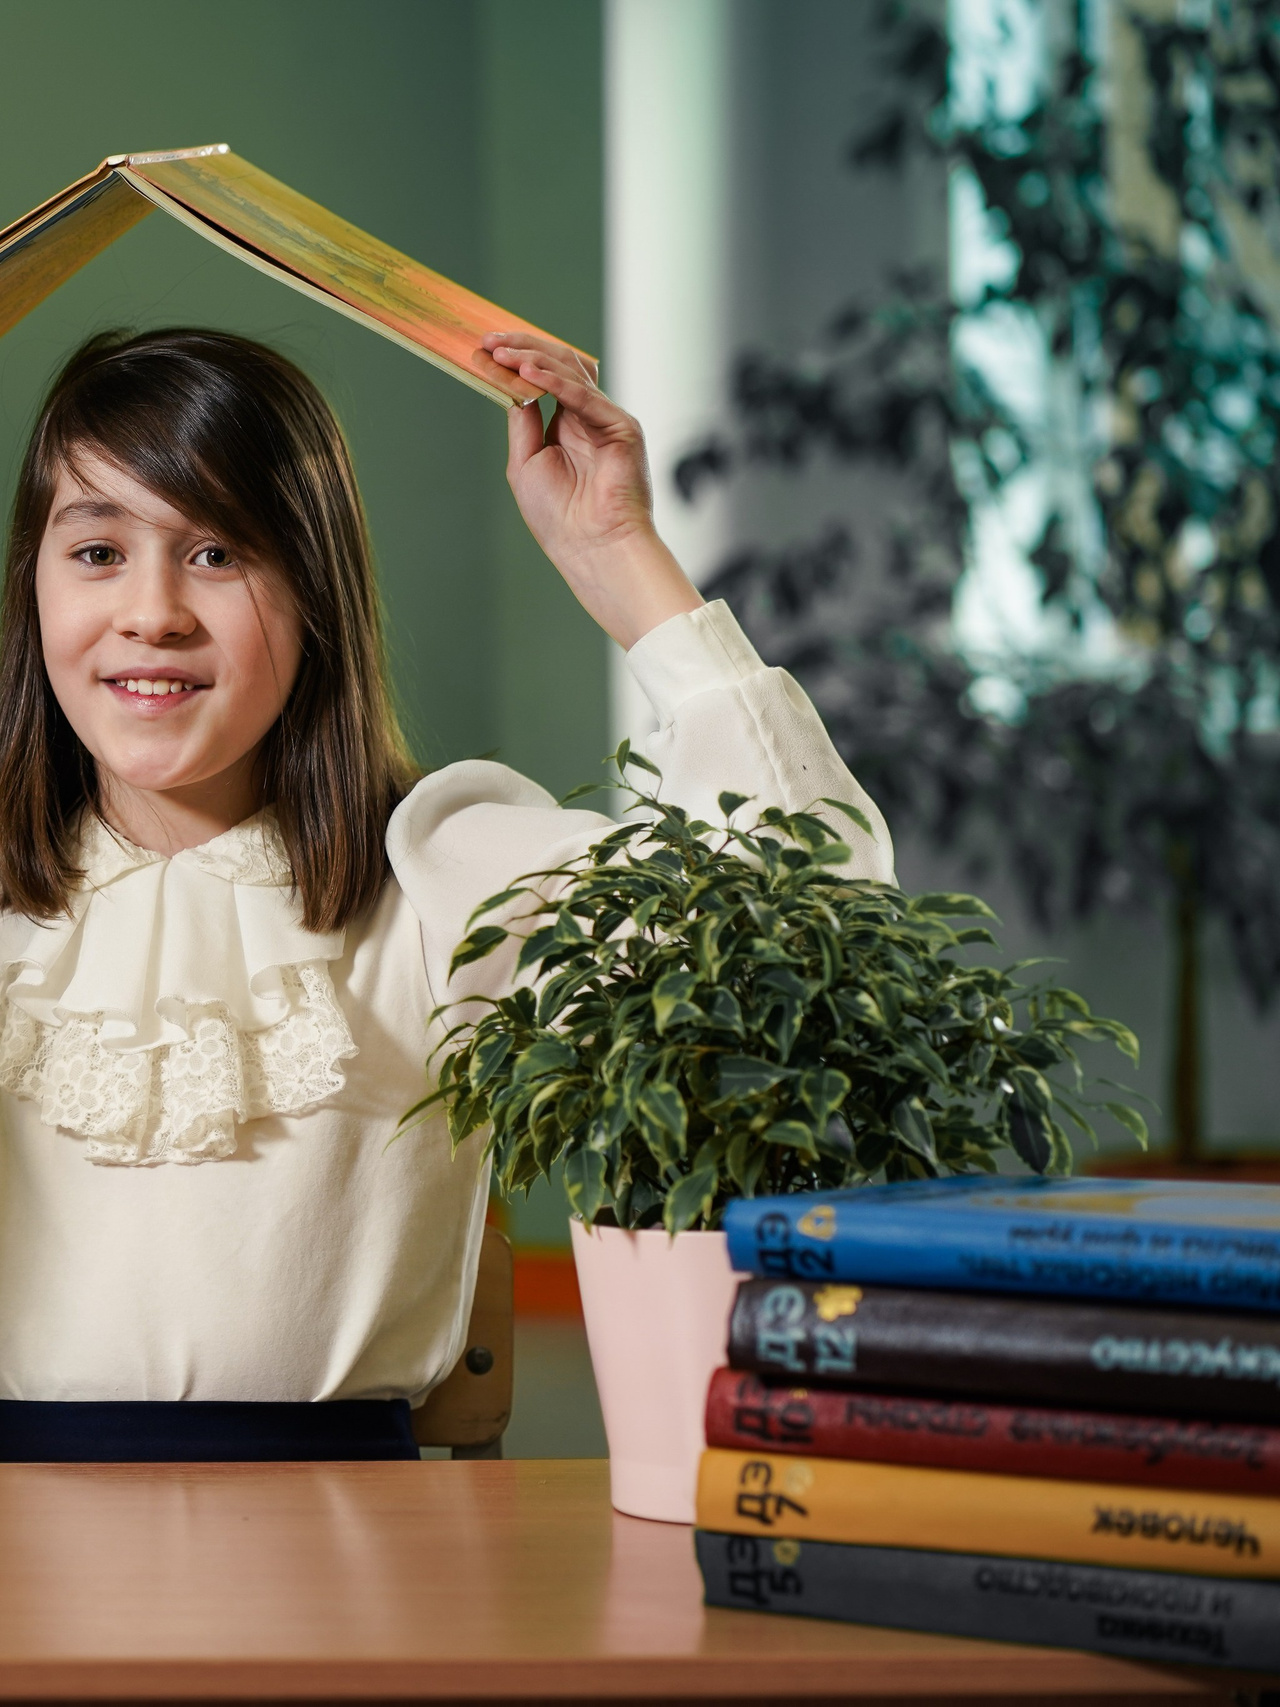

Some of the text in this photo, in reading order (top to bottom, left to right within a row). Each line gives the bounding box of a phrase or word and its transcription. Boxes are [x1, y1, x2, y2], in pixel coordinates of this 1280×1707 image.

[791, 1247, 835, 1276] 2
[756, 1285, 806, 1372] ДЭ
[815, 1324, 856, 1373] 12
[1090, 1334, 1280, 1381] скусство
[779, 1402, 814, 1444] 10
[736, 1460, 775, 1526] ДЭ
[775, 1493, 808, 1518] 7
[1092, 1505, 1262, 1557] Человек
[727, 1535, 768, 1605] ДЭ
[771, 1567, 803, 1596] 5
